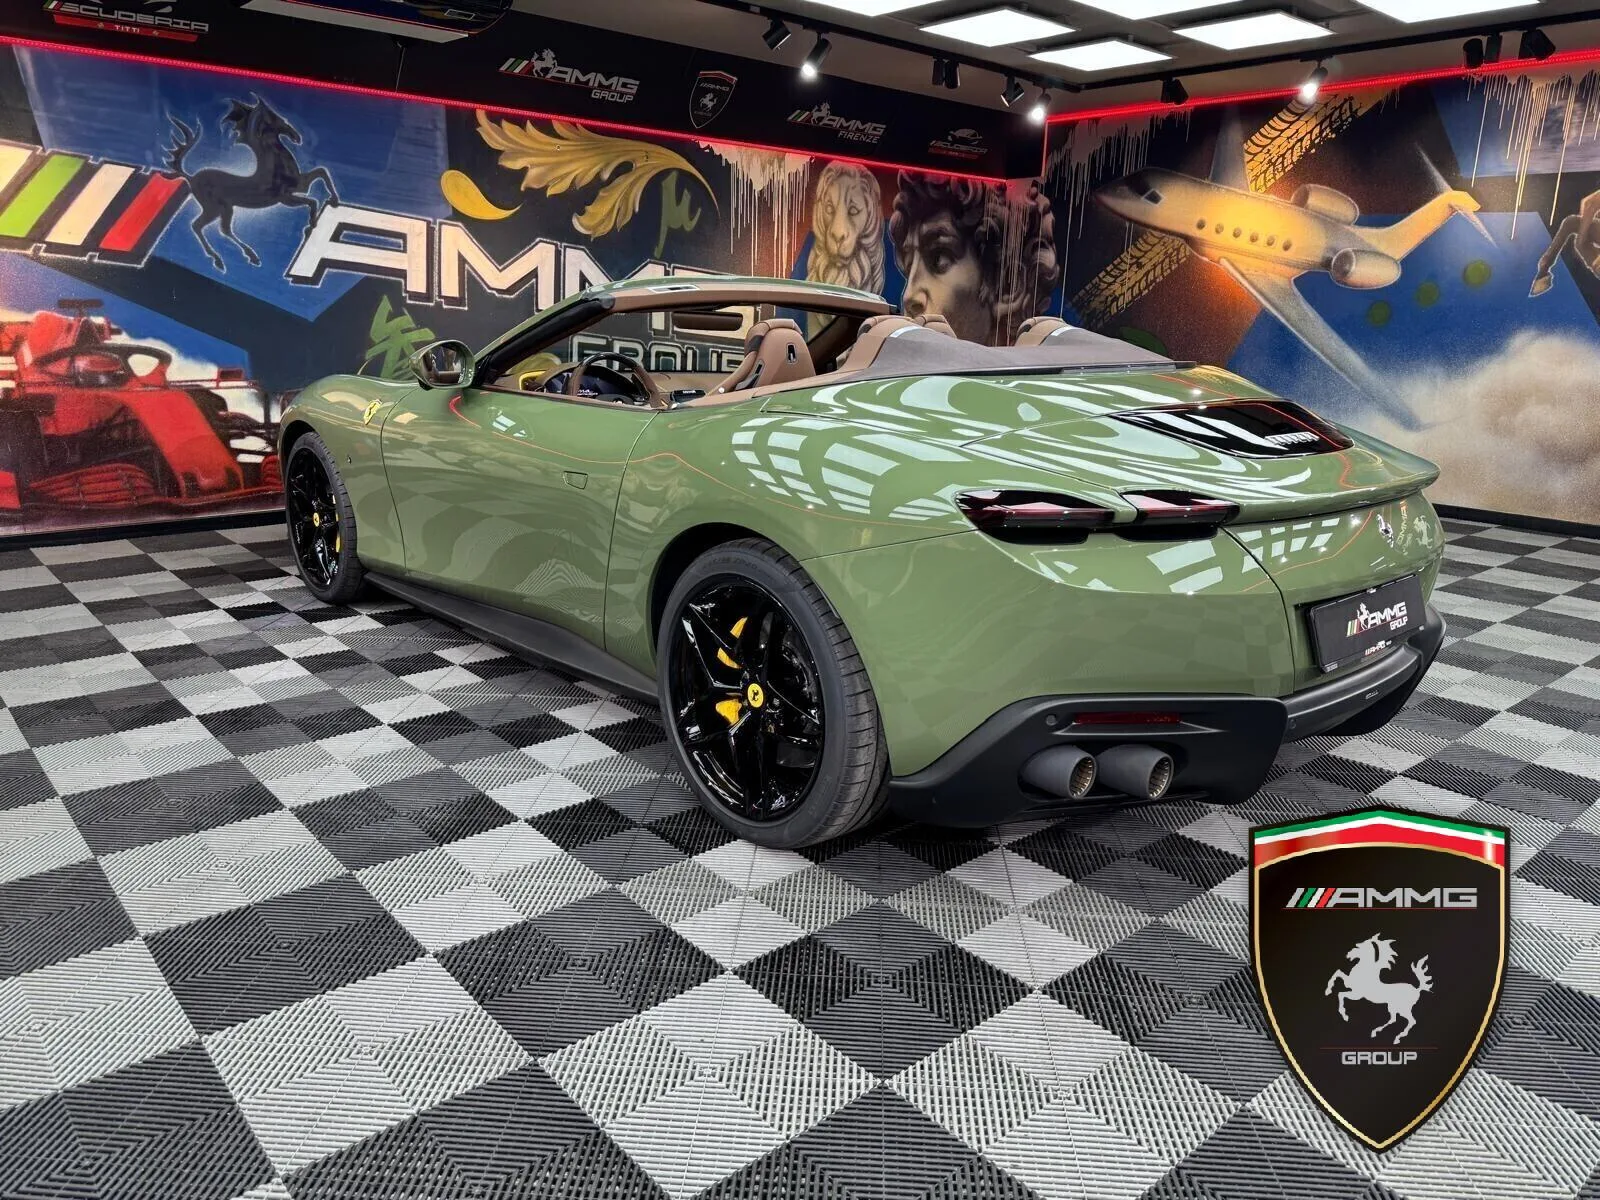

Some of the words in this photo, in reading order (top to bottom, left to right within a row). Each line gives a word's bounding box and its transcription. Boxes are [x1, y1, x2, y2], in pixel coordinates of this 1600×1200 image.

[59, 2, 209, 33] SCUDERIA
[114, 24, 140, 33] TITTI
[547, 64, 641, 94] AMMG
[591, 89, 634, 104] GROUP
[820, 114, 887, 135] AMMG
[837, 130, 881, 144] FIRENZE
[1367, 601, 1408, 629] AMMG
[1389, 616, 1408, 631] GROUP
